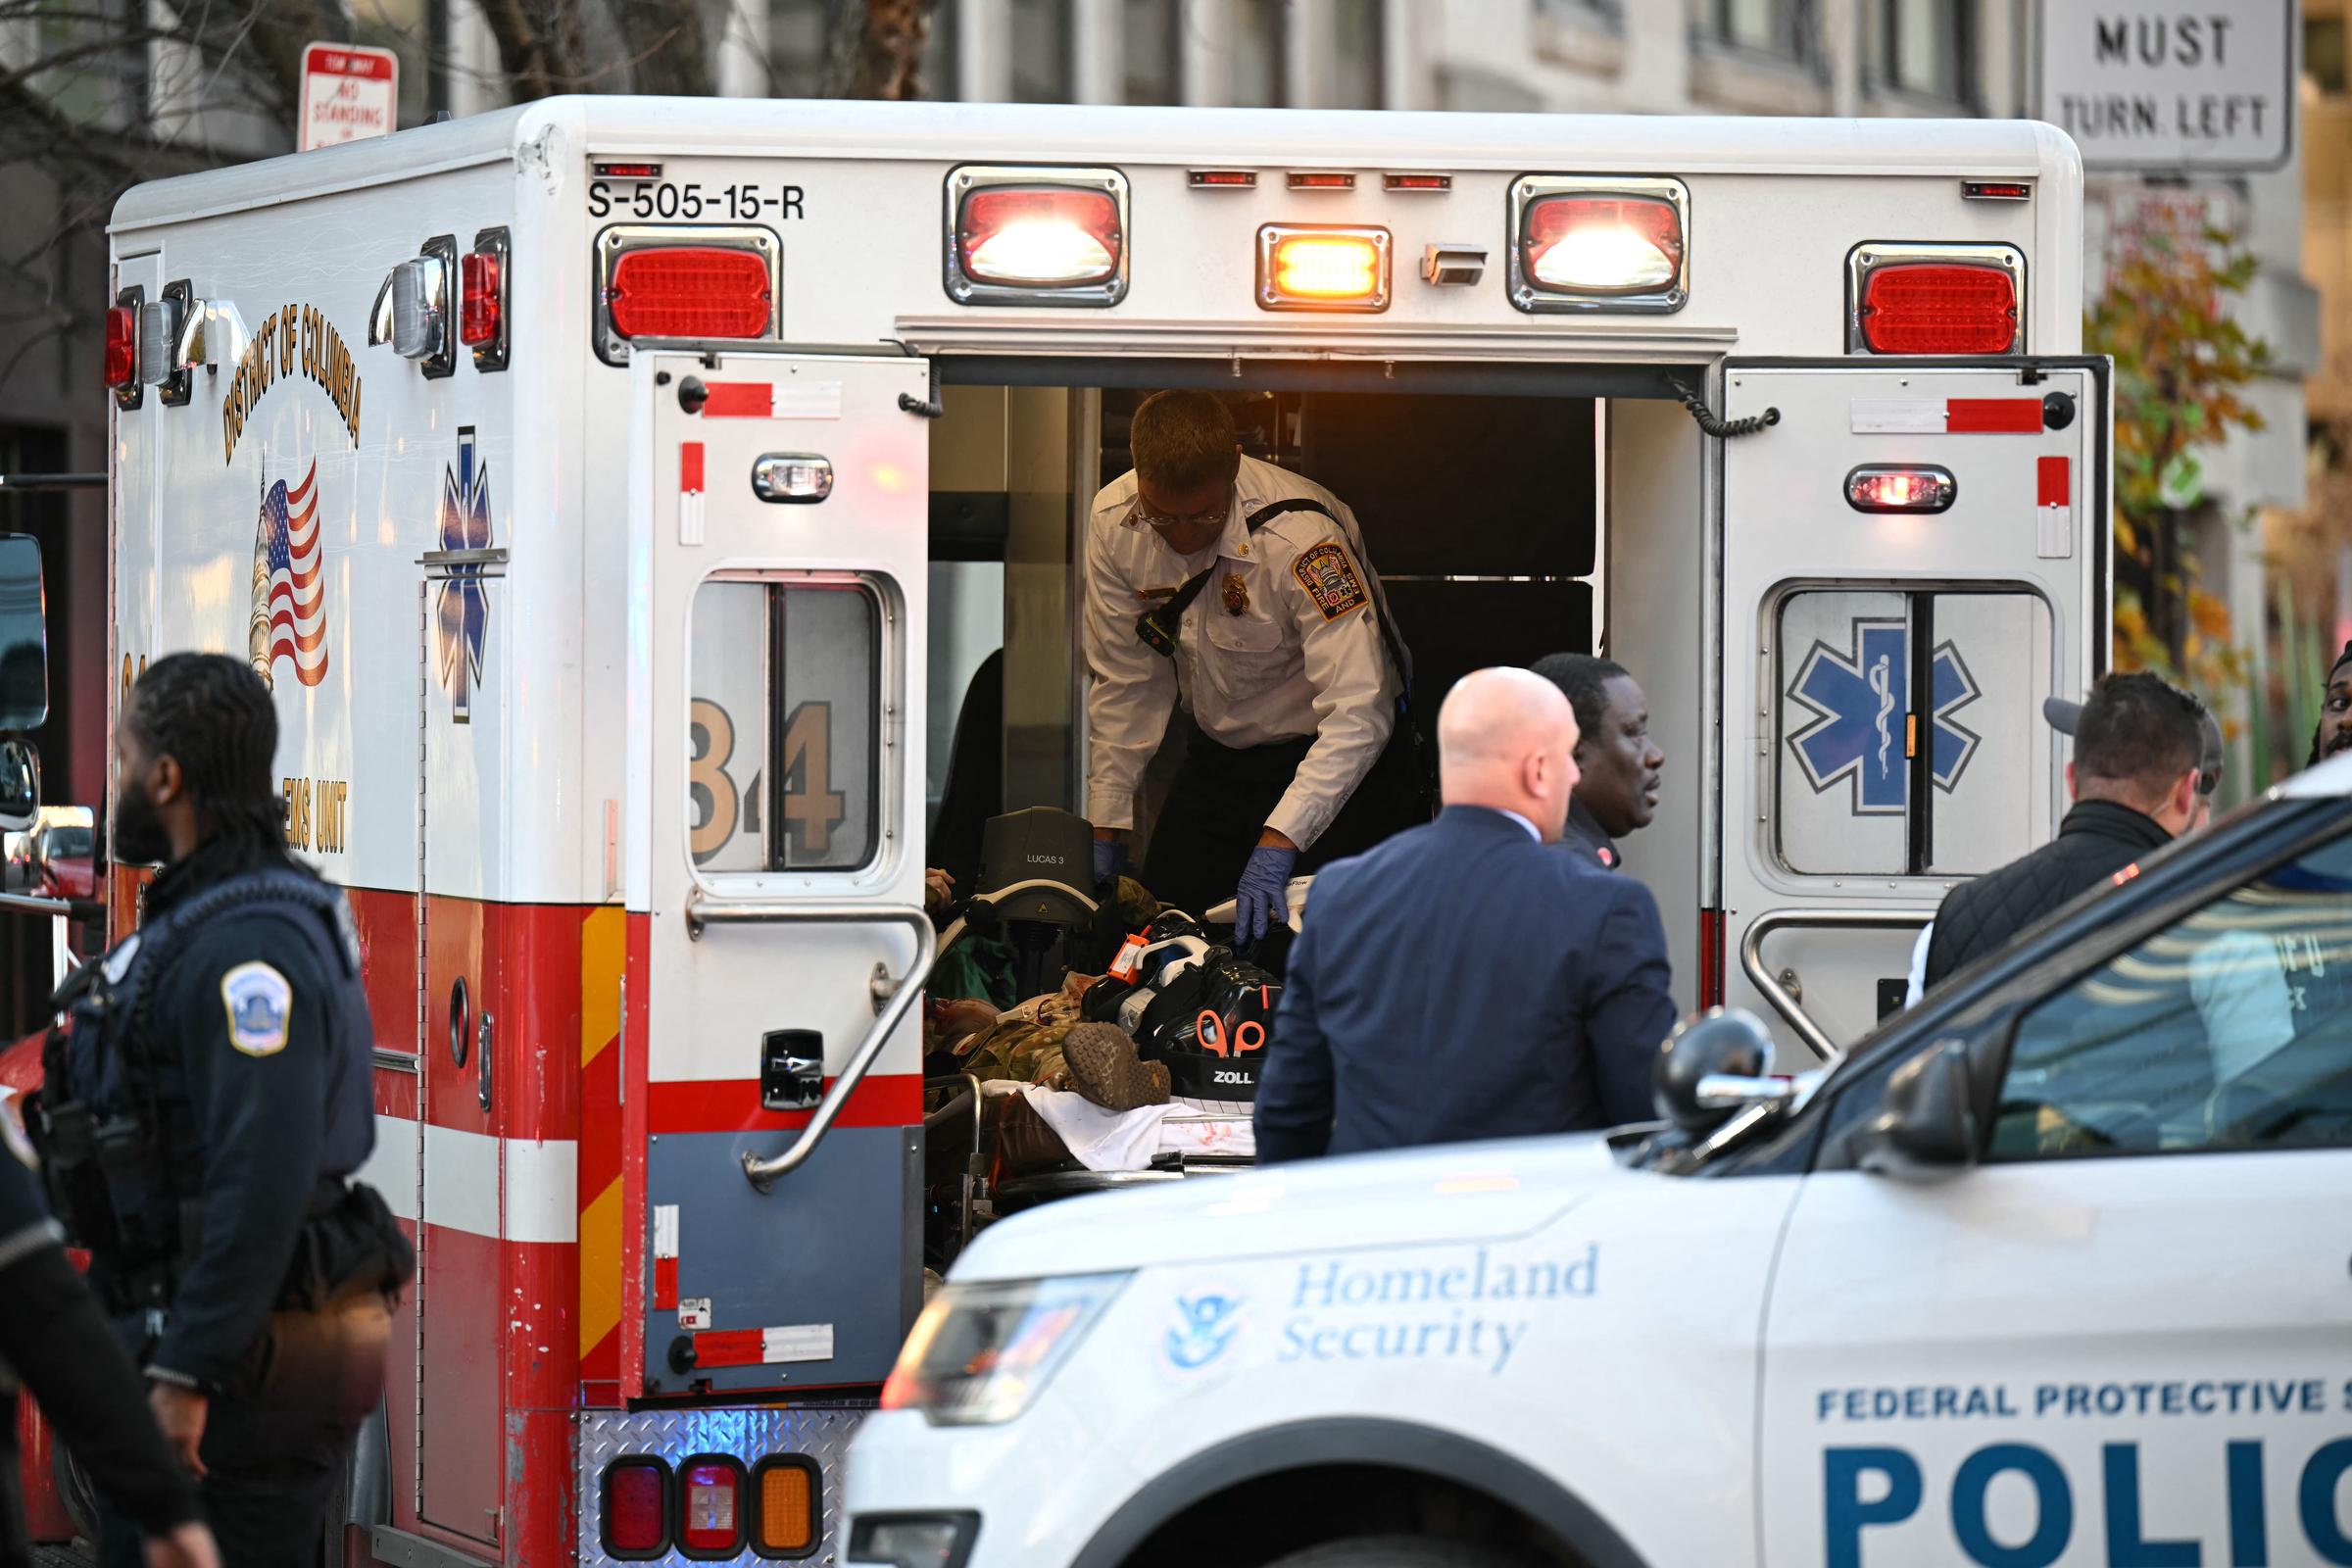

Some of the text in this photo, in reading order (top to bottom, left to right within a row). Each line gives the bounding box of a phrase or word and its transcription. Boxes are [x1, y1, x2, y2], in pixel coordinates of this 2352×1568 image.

[2094, 15, 2232, 68] MUST
[337, 79, 360, 100] NO
[313, 100, 384, 128] STANDING
[2060, 94, 2268, 138] TURN LEFT
[588, 181, 805, 220] S-505-15-R
[222, 302, 362, 467] DISTRICT OF COLUMBIA
[1309, 549, 1321, 560] OF
[1312, 588, 1330, 611] FIRE
[1336, 599, 1355, 613] AND
[282, 776, 348, 855] EMS UNIT
[1026, 854, 1064, 865] LUCAS 3
[1290, 1240, 1600, 1308] Homeland
[1276, 1306, 1530, 1377] Security
[1815, 1385, 2018, 1421] FEDERAL
[2034, 1379, 2328, 1418] PROTECTIVE
